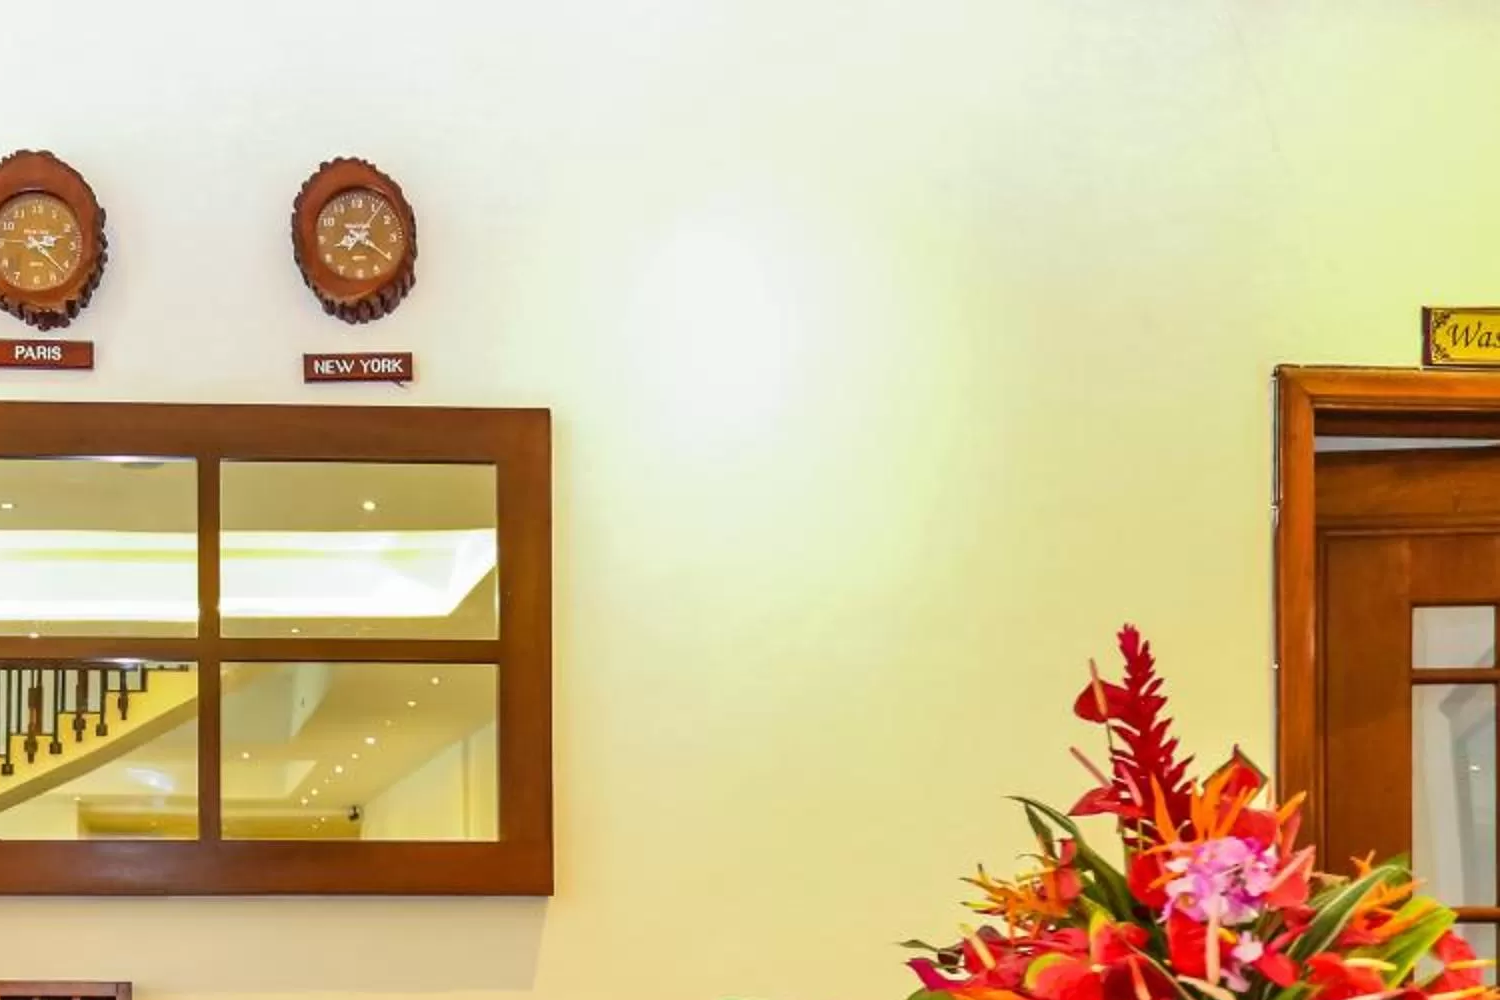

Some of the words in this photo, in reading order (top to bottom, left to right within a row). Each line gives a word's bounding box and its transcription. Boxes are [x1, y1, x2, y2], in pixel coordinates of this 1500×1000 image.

[14, 345, 62, 361] PARIS
[313, 359, 355, 374] NEW
[359, 357, 404, 374] YORK
